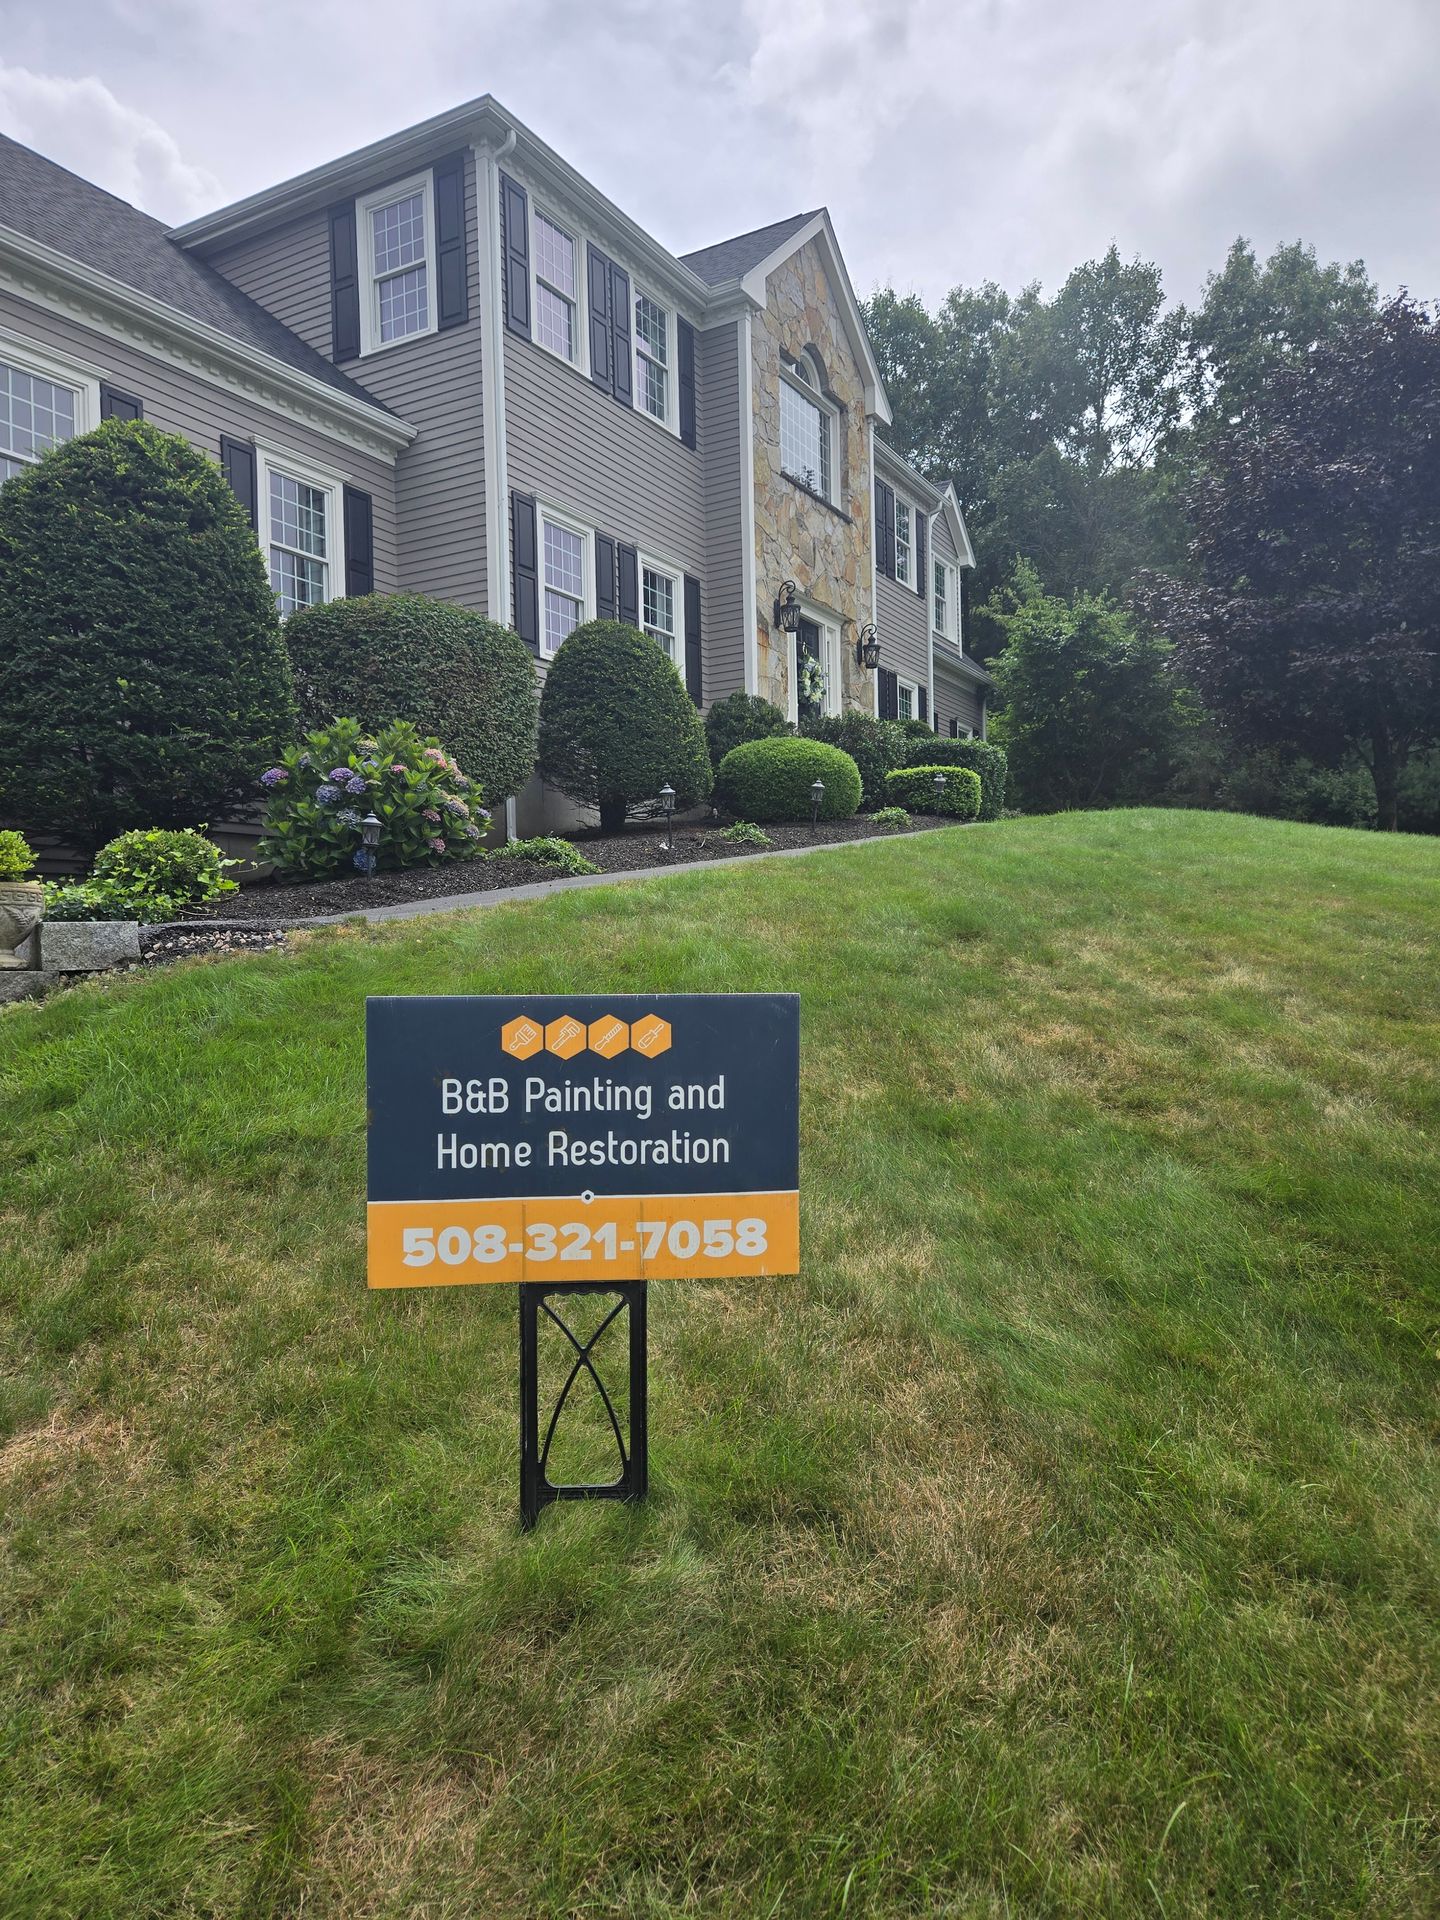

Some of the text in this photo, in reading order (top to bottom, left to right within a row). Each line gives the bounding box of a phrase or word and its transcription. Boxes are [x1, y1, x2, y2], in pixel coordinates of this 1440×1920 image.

[441, 1074, 726, 1121] B&B Painting and
[436, 1128, 730, 1170] Home Restoration
[402, 1218, 769, 1268] 508-321-7058
